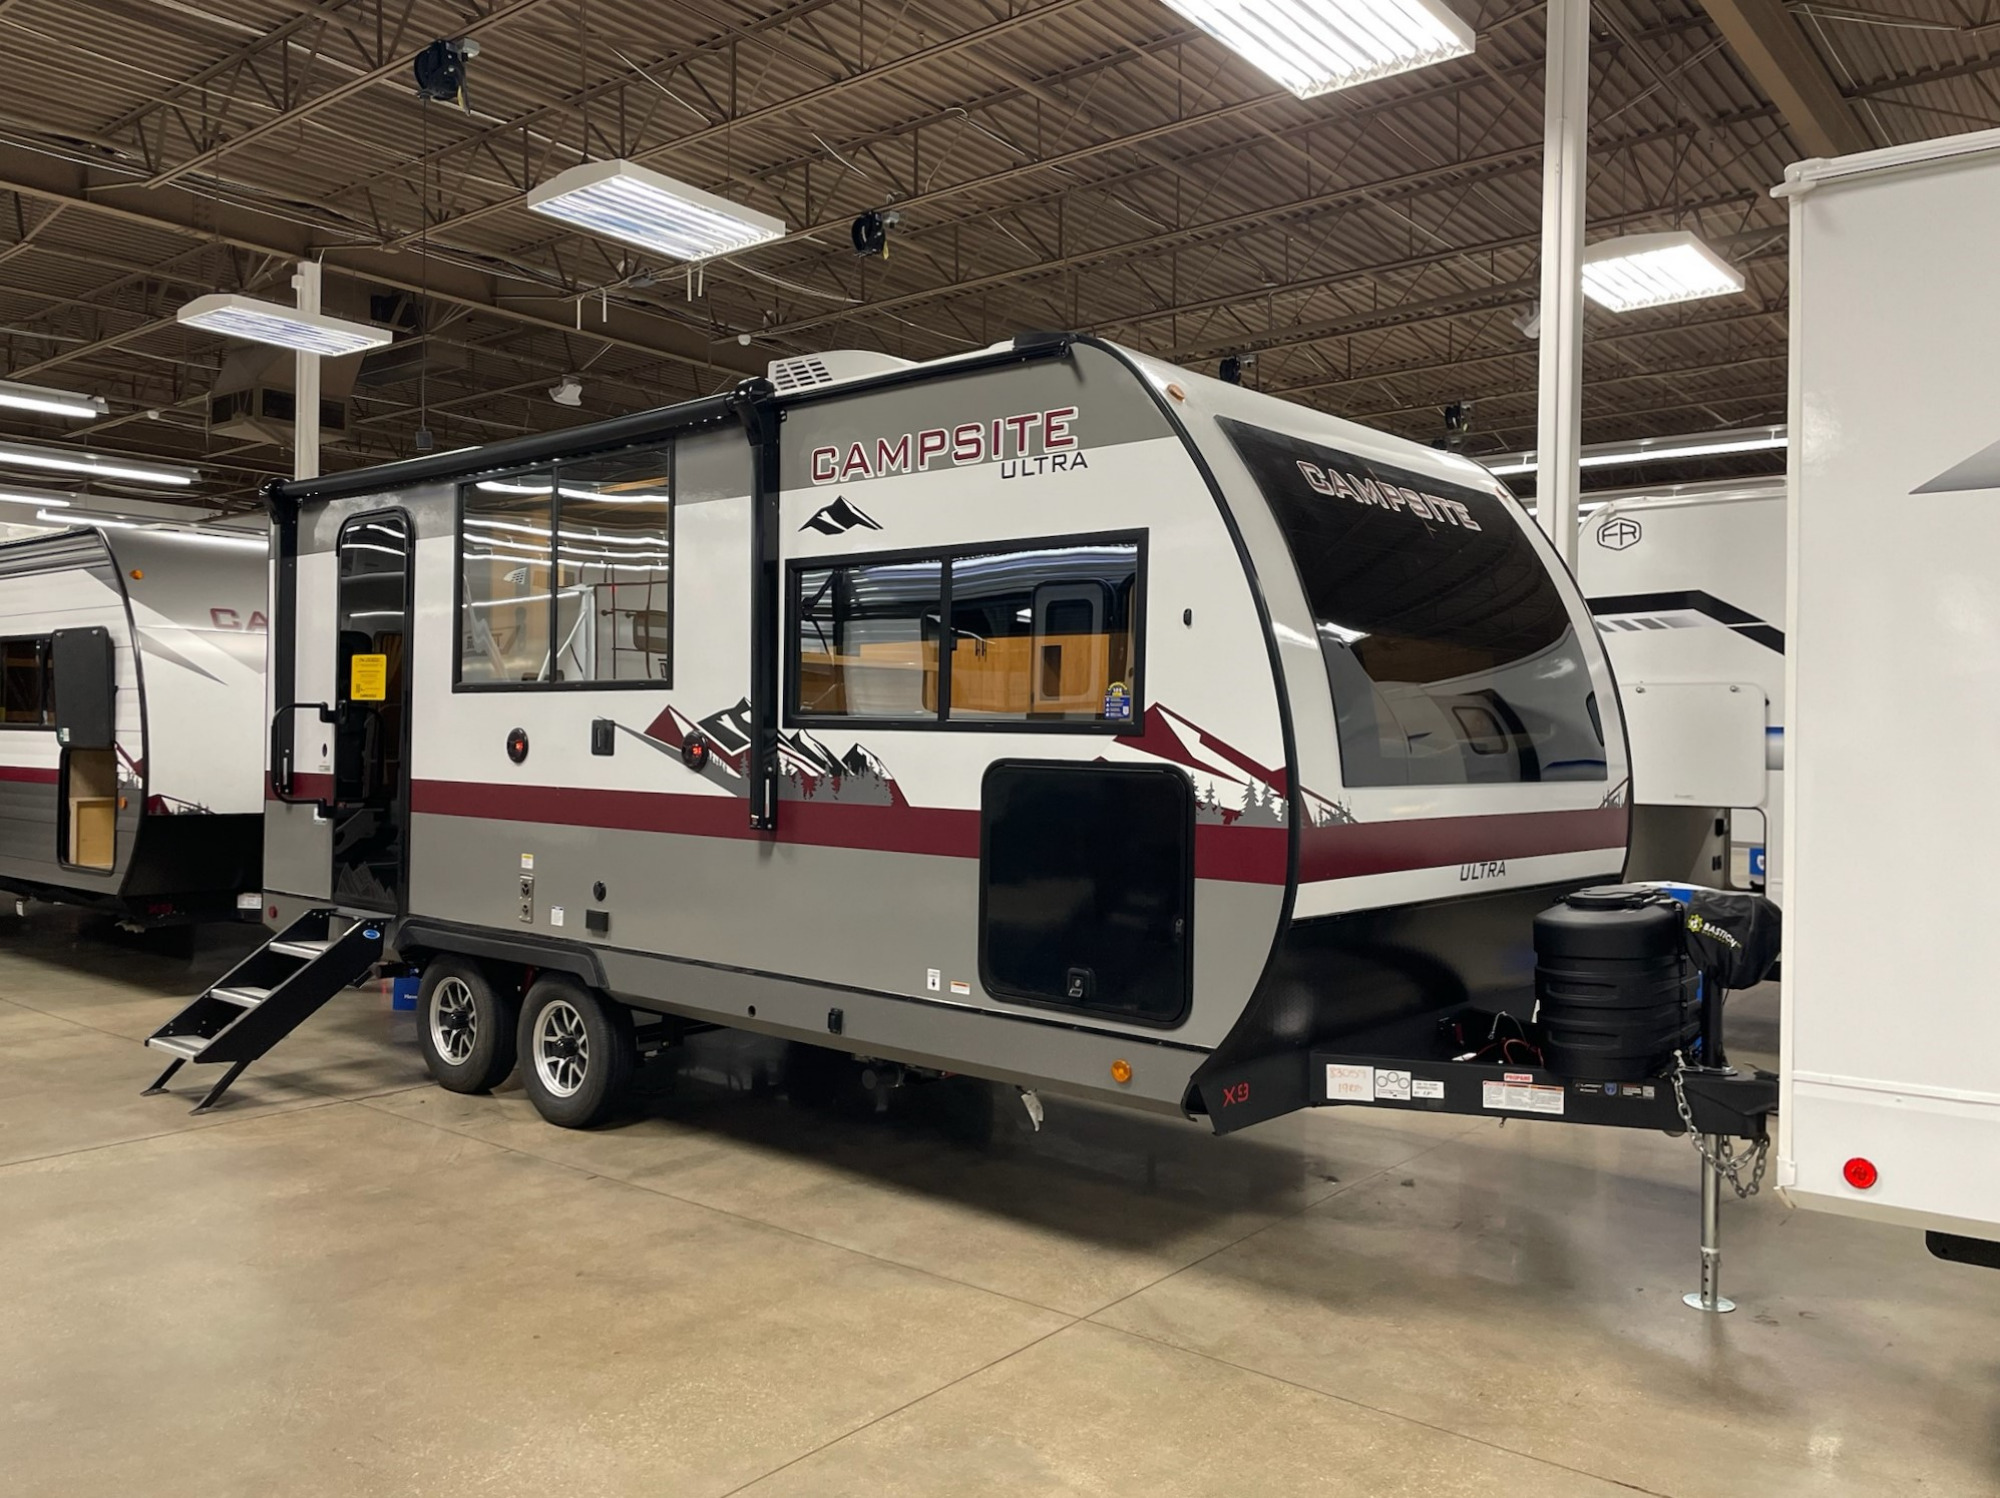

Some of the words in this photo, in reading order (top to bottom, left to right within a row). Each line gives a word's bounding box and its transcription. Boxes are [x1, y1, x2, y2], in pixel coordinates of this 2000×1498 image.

[811, 406, 1079, 485] CAMPSITE
[1001, 451, 1089, 479] ULTRA
[1296, 460, 1482, 532] CAMPSITE
[1460, 861, 1506, 881] ULTRA
